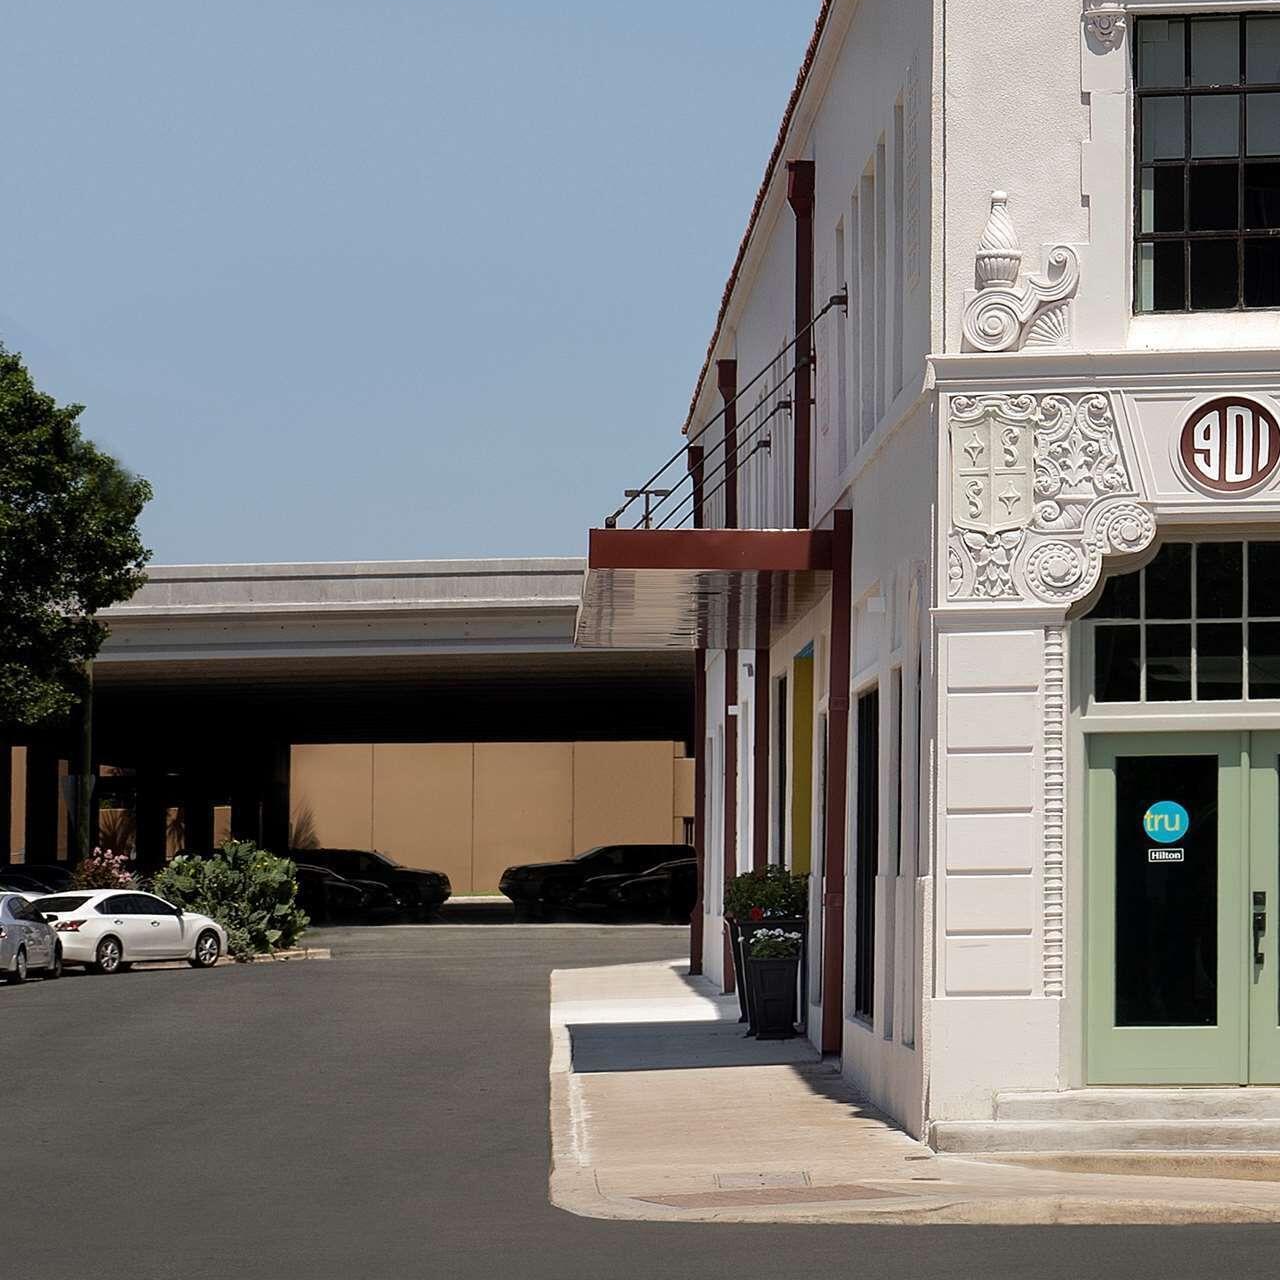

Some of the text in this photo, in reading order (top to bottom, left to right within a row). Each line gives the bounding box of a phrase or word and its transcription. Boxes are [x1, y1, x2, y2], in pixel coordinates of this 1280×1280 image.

[1193, 405, 1270, 483] 901
[1144, 810, 1180, 832] tru
[1151, 851, 1181, 860] Hilton
